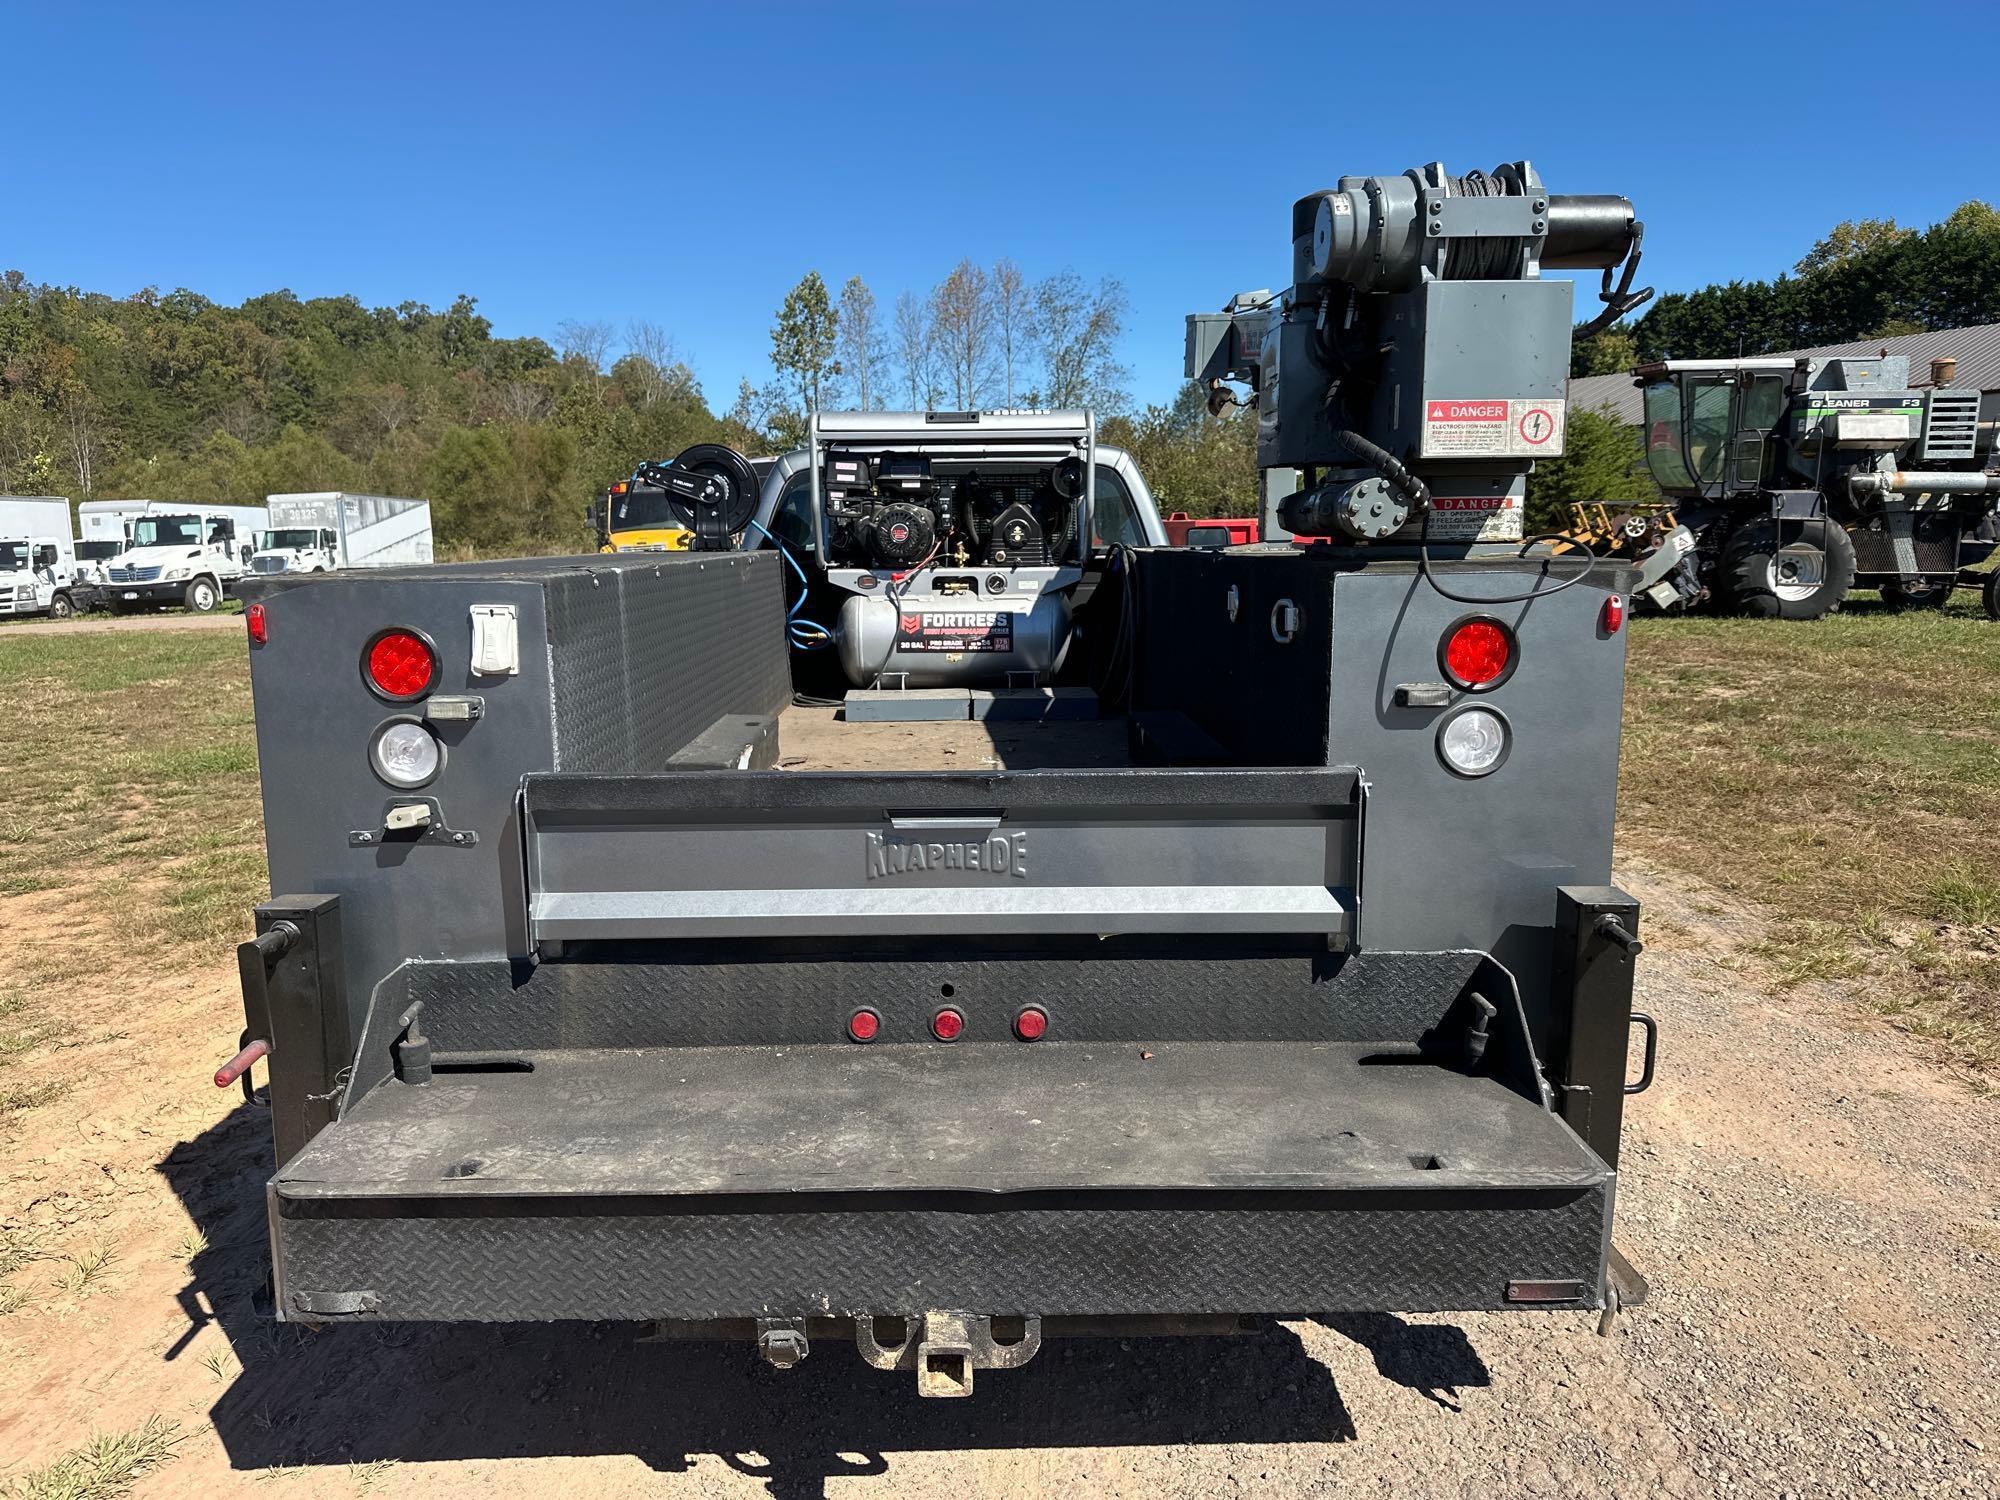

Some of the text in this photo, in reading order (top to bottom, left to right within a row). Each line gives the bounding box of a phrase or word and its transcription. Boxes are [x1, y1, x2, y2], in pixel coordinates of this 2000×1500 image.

[1902, 399, 1920, 407] F3
[1450, 406, 1504, 417] DANGER
[1444, 499, 1507, 509] DANGER
[923, 613, 1008, 627] FORTRESS
[900, 641, 910, 649] 30
[866, 831, 1027, 880] KNAPHEIDE
